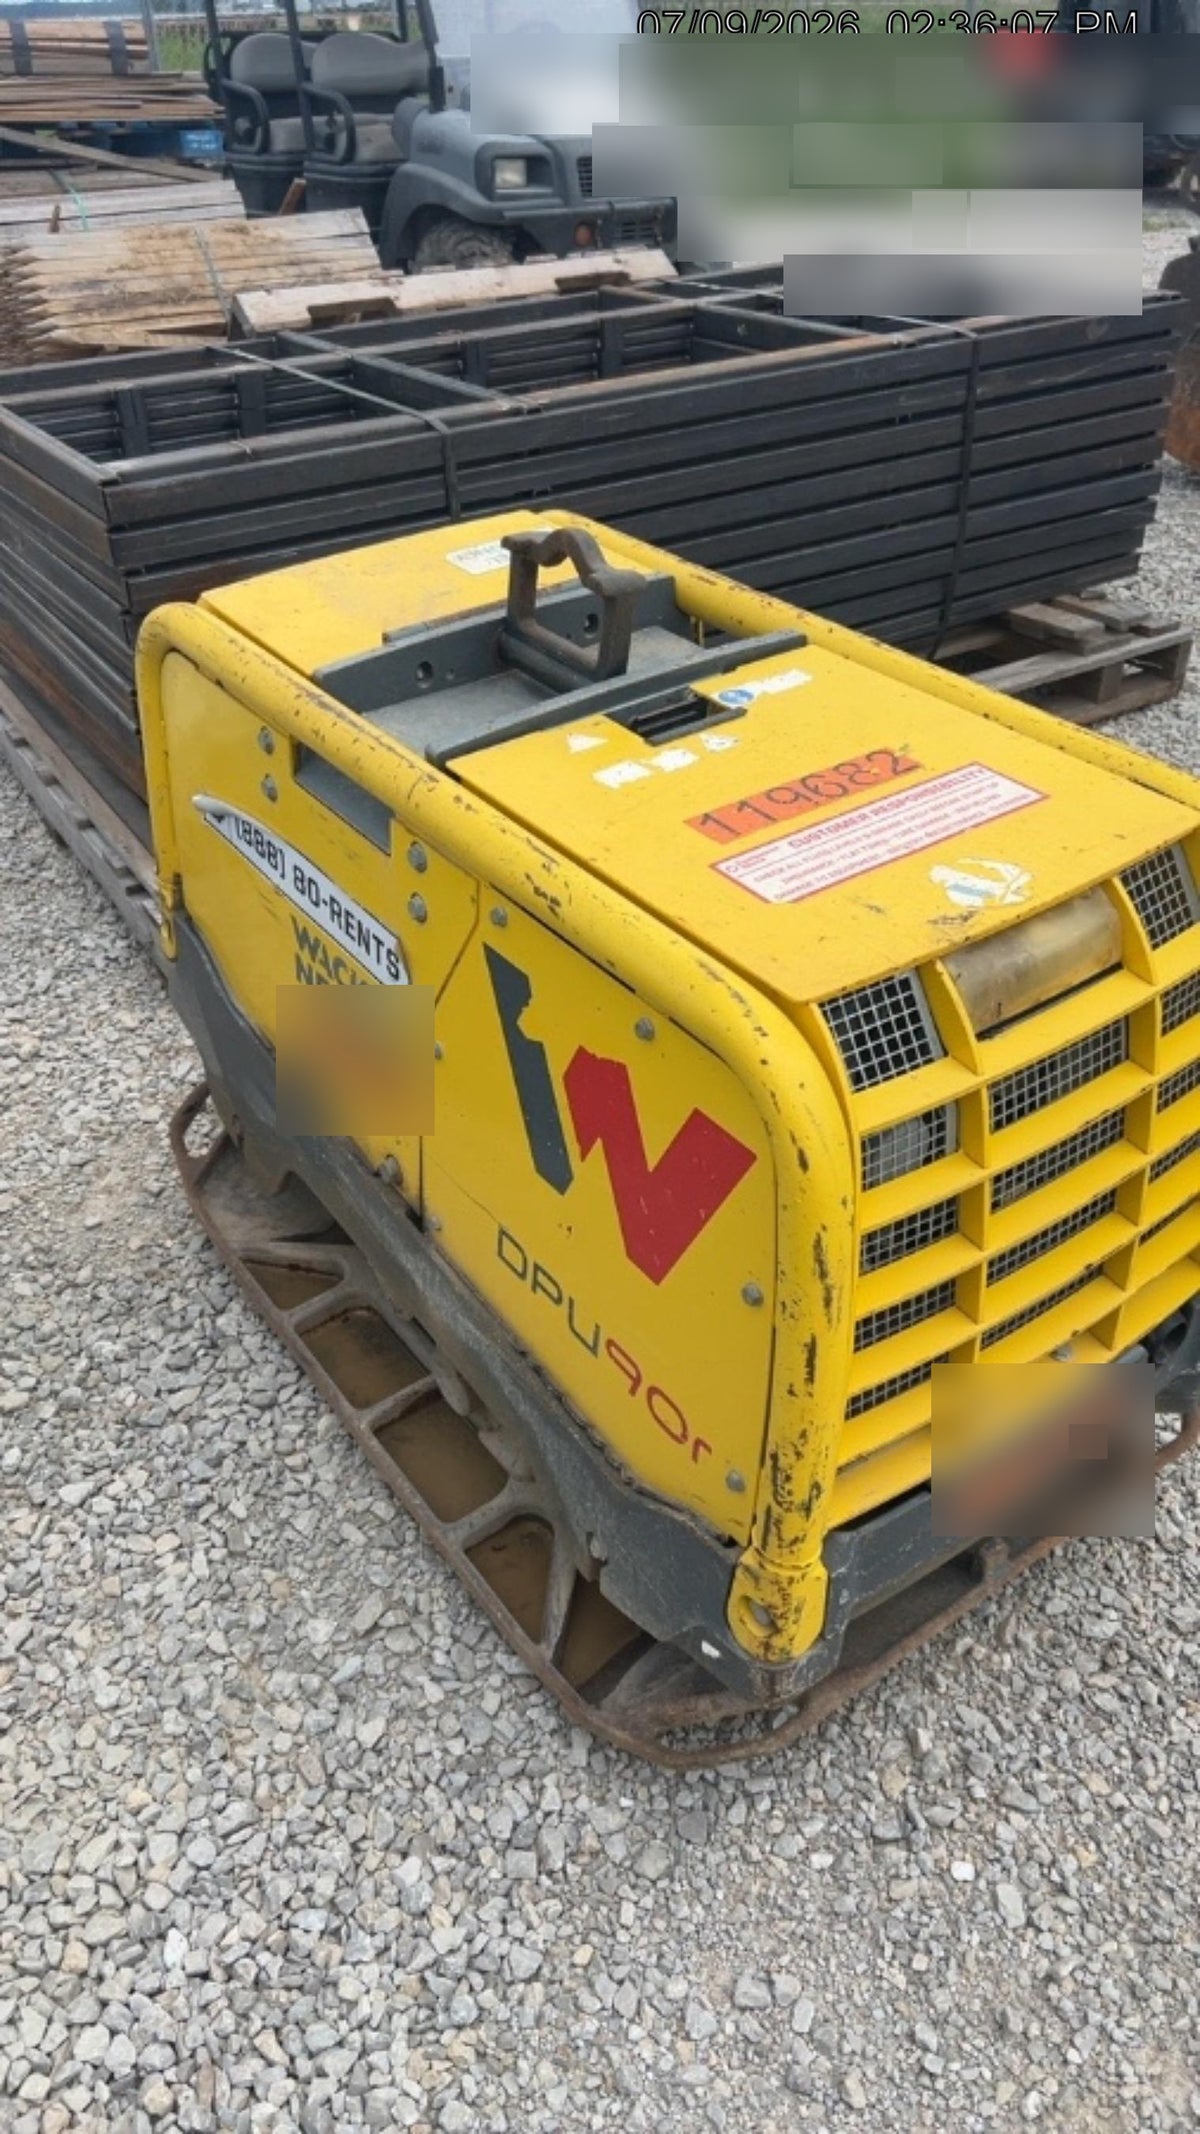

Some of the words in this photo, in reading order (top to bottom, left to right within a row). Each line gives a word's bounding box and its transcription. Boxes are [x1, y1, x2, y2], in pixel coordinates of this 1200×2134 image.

[700, 747, 922, 836] 119682
[788, 812, 871, 849] CUSTOMER
[870, 767, 987, 819] RESPONSIBILITY
[234, 817, 285, 880] (888)
[293, 864, 400, 982] 80-RENTS
